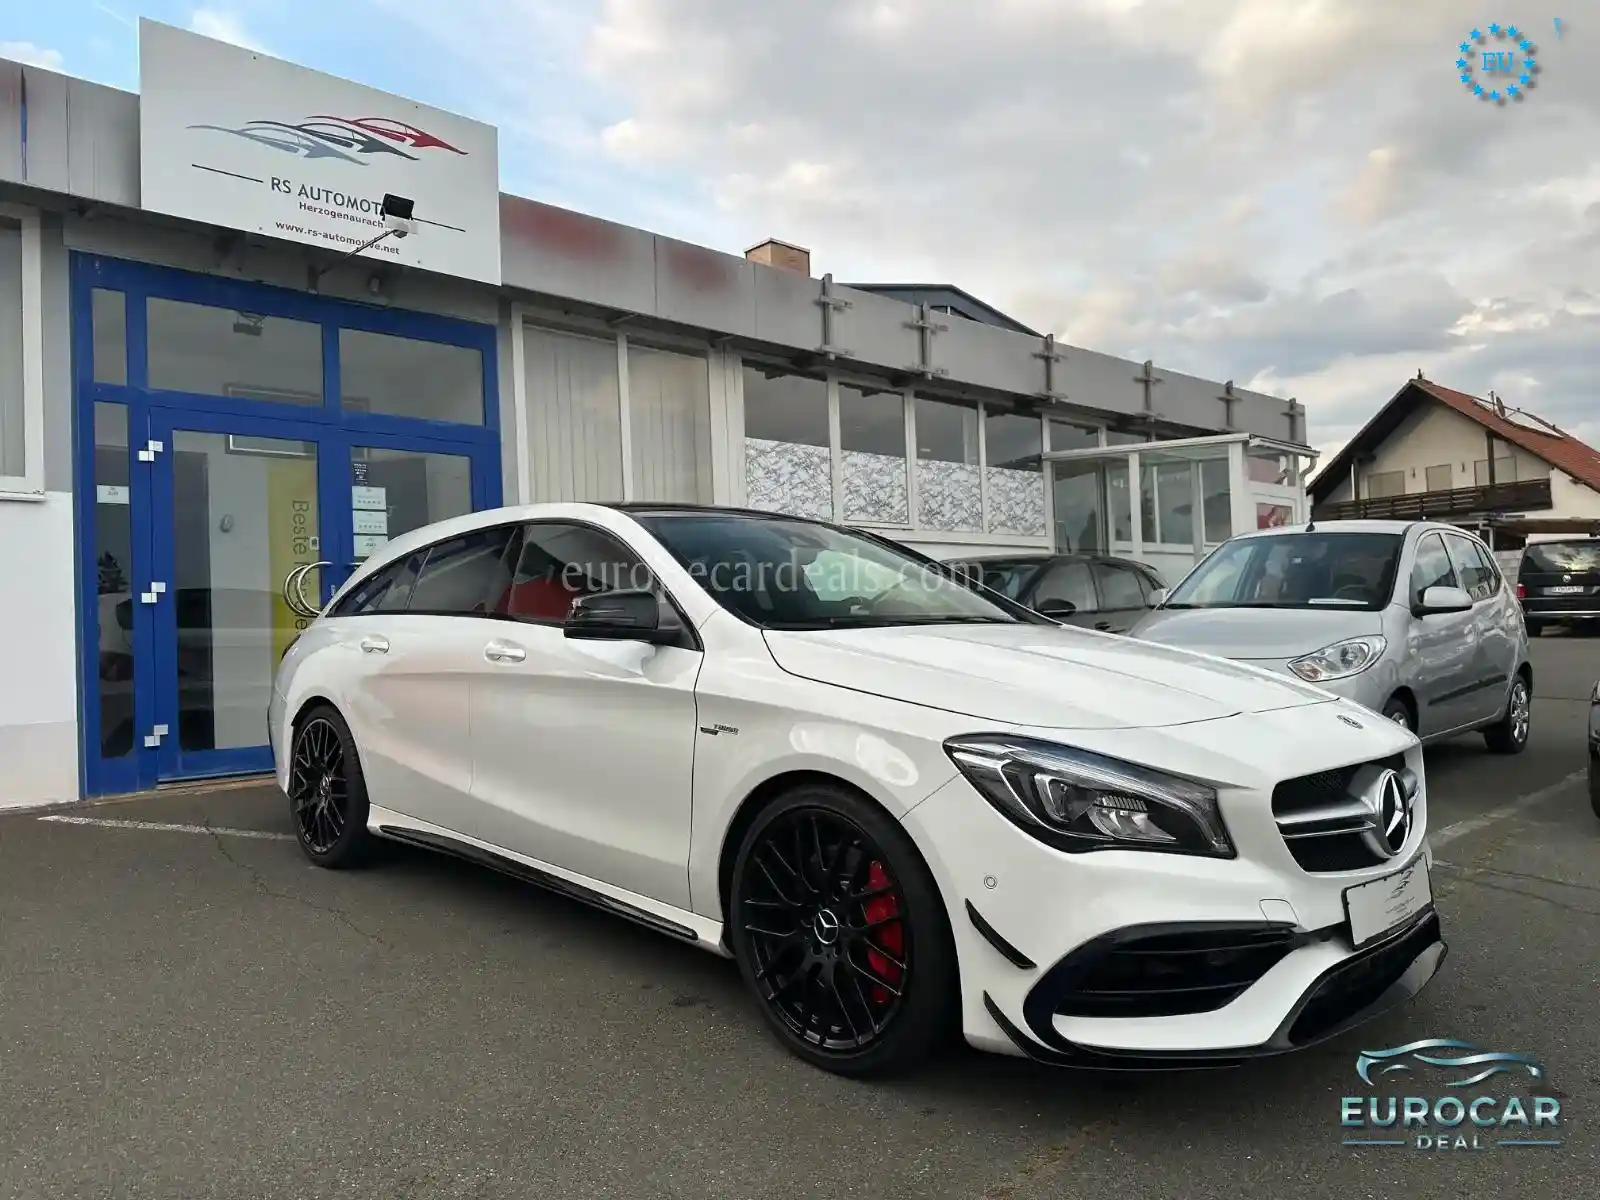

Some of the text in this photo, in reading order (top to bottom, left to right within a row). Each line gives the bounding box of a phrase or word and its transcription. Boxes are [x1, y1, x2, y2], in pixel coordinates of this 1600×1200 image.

[271, 177, 383, 215] RS AUTOMOT
[299, 202, 384, 228] Herzogenaurach
[292, 500, 310, 555] Beste
